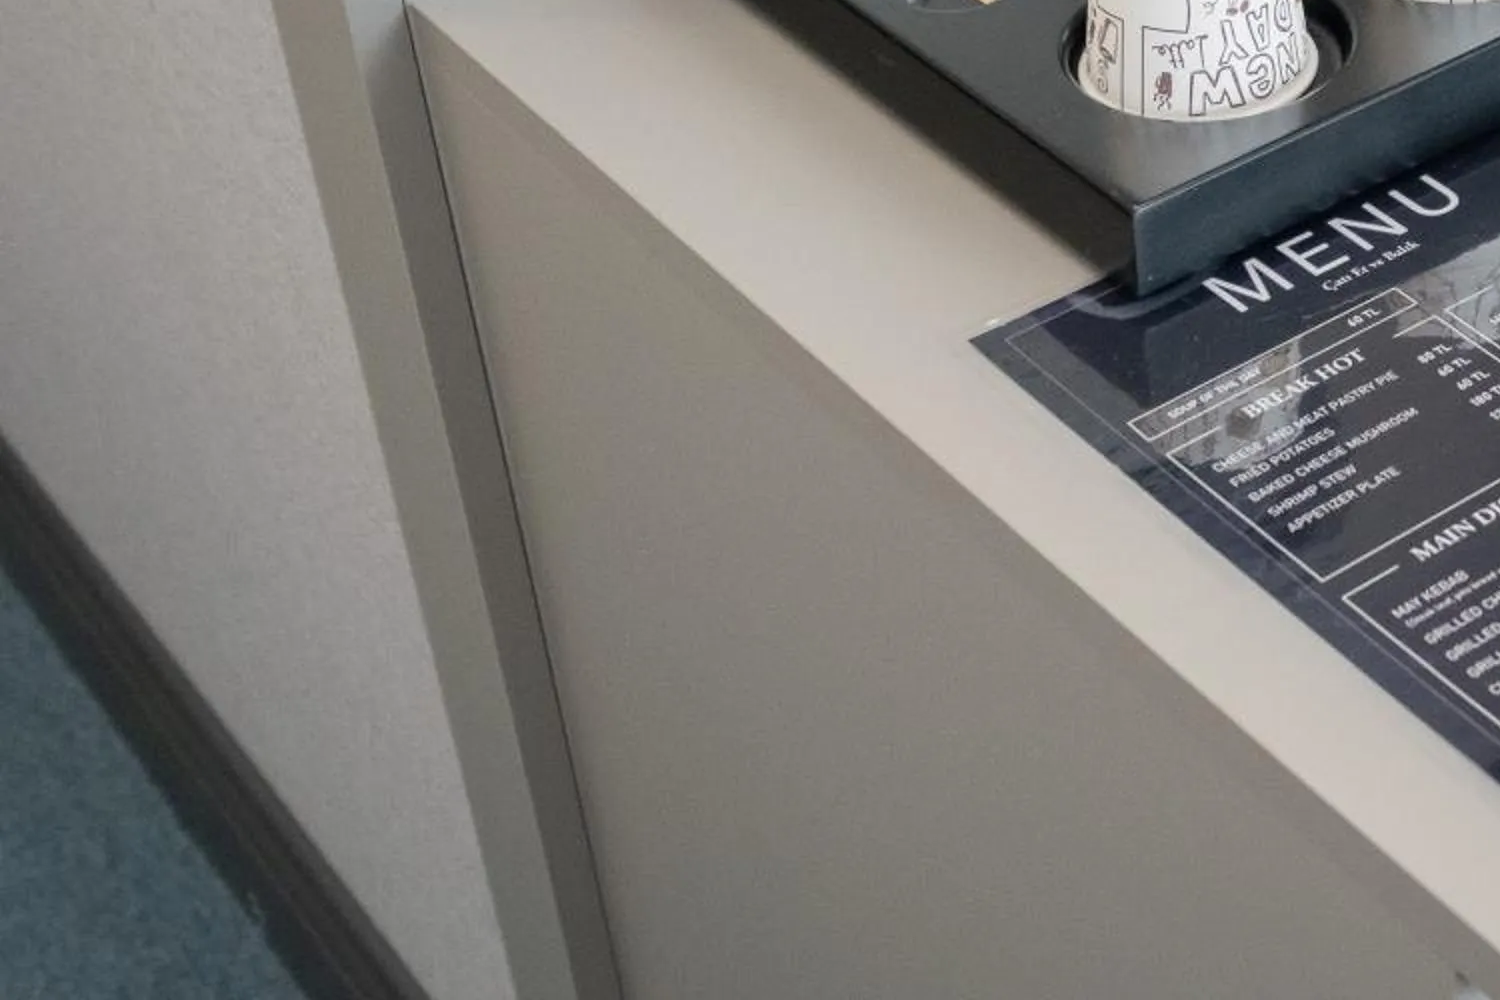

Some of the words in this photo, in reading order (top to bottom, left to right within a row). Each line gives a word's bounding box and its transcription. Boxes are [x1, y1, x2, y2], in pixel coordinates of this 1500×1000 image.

[1204, 175, 1458, 311] MENU
[1359, 307, 1381, 319] TL
[1241, 374, 1318, 417] BREAK
[1313, 347, 1364, 380] HOT
[1210, 440, 1264, 473] CHEESE
[1264, 424, 1295, 445] AND
[1292, 405, 1329, 429] MEAT
[1326, 381, 1375, 411] PASTRY
[1373, 369, 1399, 386] PIE
[1228, 461, 1270, 487] FRIED
[1268, 426, 1335, 466] POTATOES
[1246, 472, 1295, 502] BAKED
[1293, 444, 1347, 477] CHEESE
[1344, 406, 1418, 449] MUSHROOM
[1266, 483, 1318, 517] SHRIMP
[1317, 463, 1357, 489] STEW
[1287, 488, 1358, 533] APPETIZER
[1354, 465, 1400, 493] PLATE
[1409, 518, 1476, 561] MAIN
[1390, 595, 1422, 619] MAY
[1419, 569, 1469, 601] KEBAB
[1423, 605, 1483, 644] GRILLED
